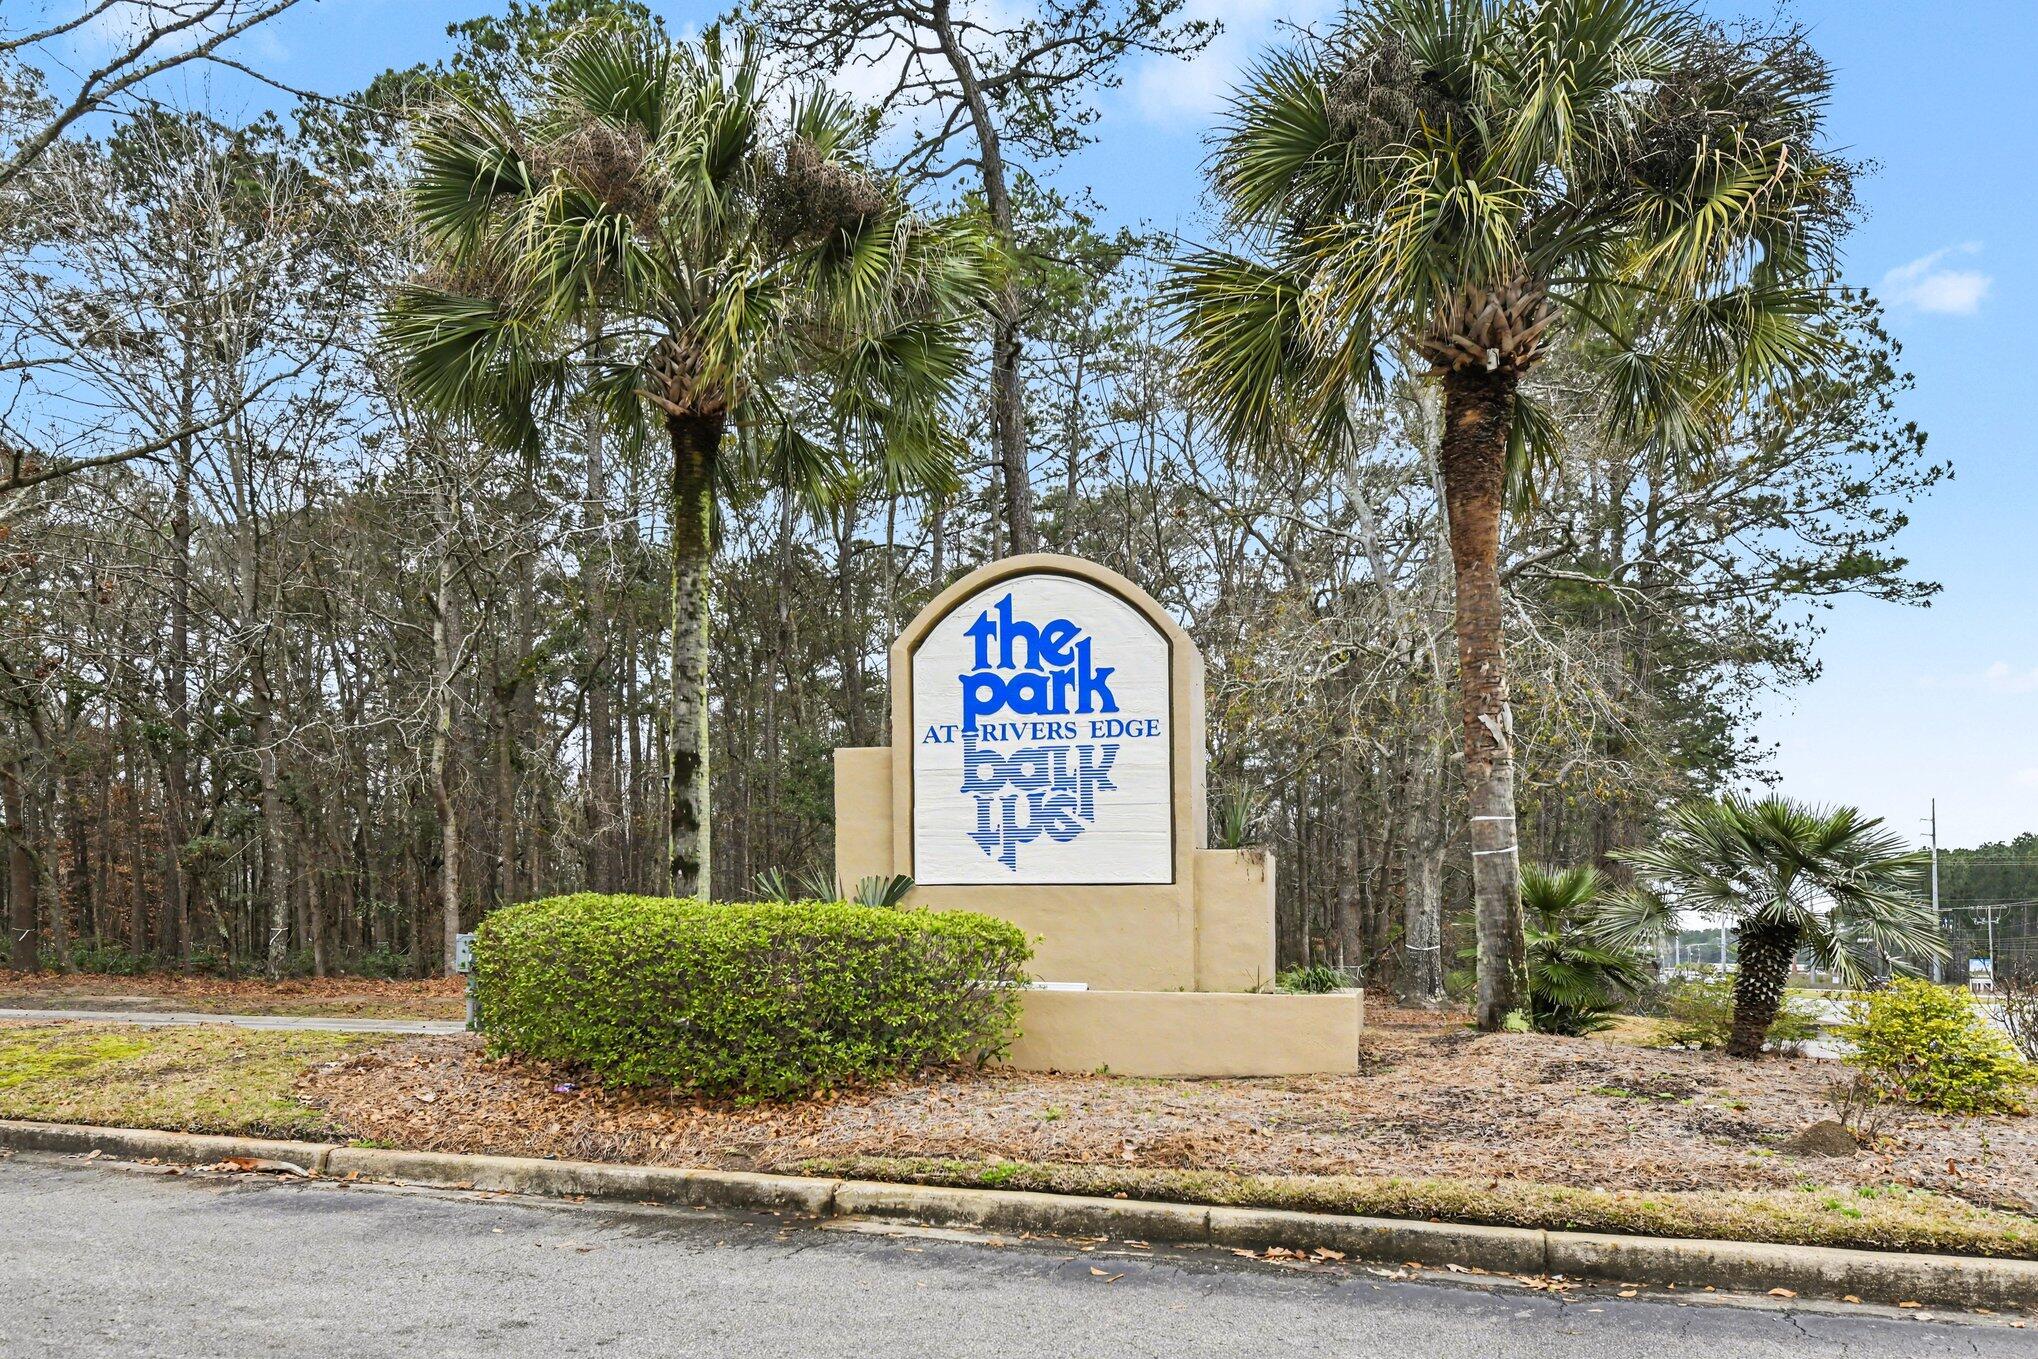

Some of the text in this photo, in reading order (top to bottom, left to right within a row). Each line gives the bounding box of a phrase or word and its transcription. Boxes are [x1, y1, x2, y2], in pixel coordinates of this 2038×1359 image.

[964, 593, 1082, 672] the
[958, 636, 1120, 733] park
[922, 718, 1161, 744] AT RIVERS EDGE
